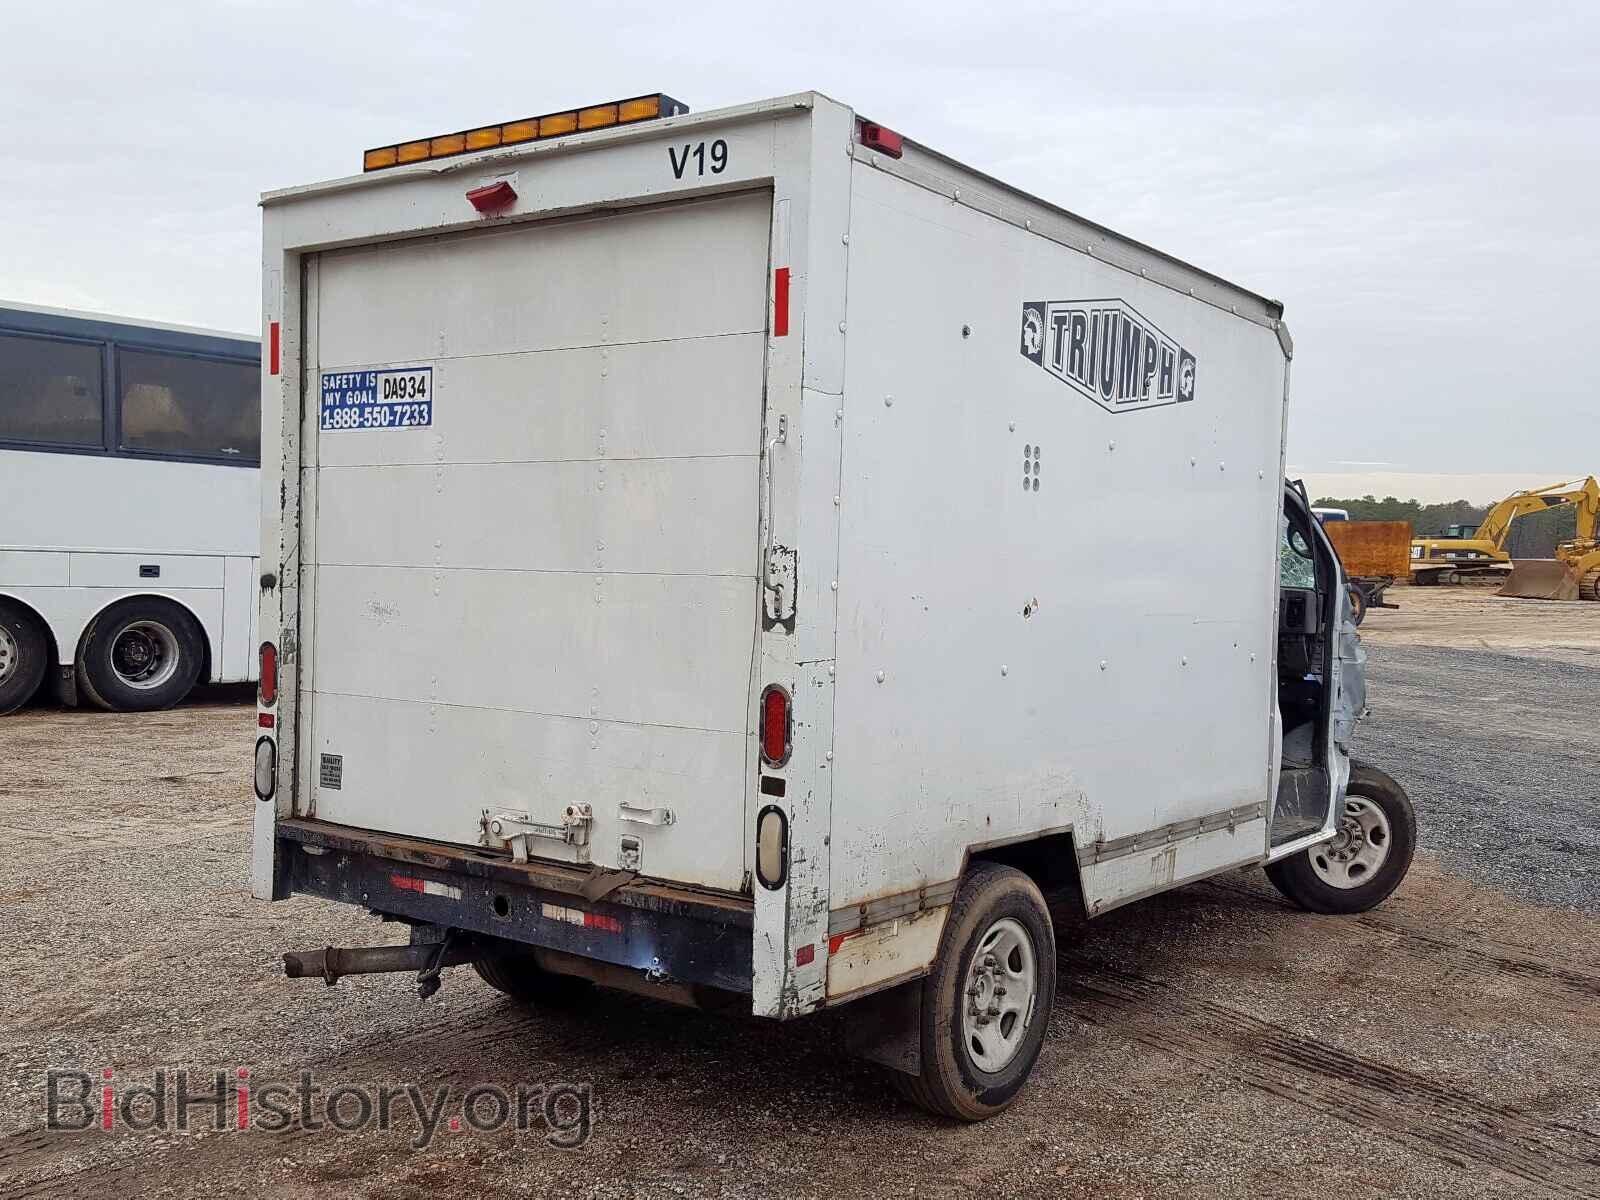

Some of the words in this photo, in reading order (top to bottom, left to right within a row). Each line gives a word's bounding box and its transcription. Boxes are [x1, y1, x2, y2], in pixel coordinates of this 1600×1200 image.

[668, 139, 728, 179] V19
[1051, 309, 1177, 404] TRIUMPH
[323, 374, 361, 390] SAFETY
[366, 373, 376, 386] IS
[383, 376, 426, 400] DA934
[325, 393, 341, 406] MY
[346, 390, 375, 404] GOAL
[322, 404, 429, 429] 1-888-550-7233
